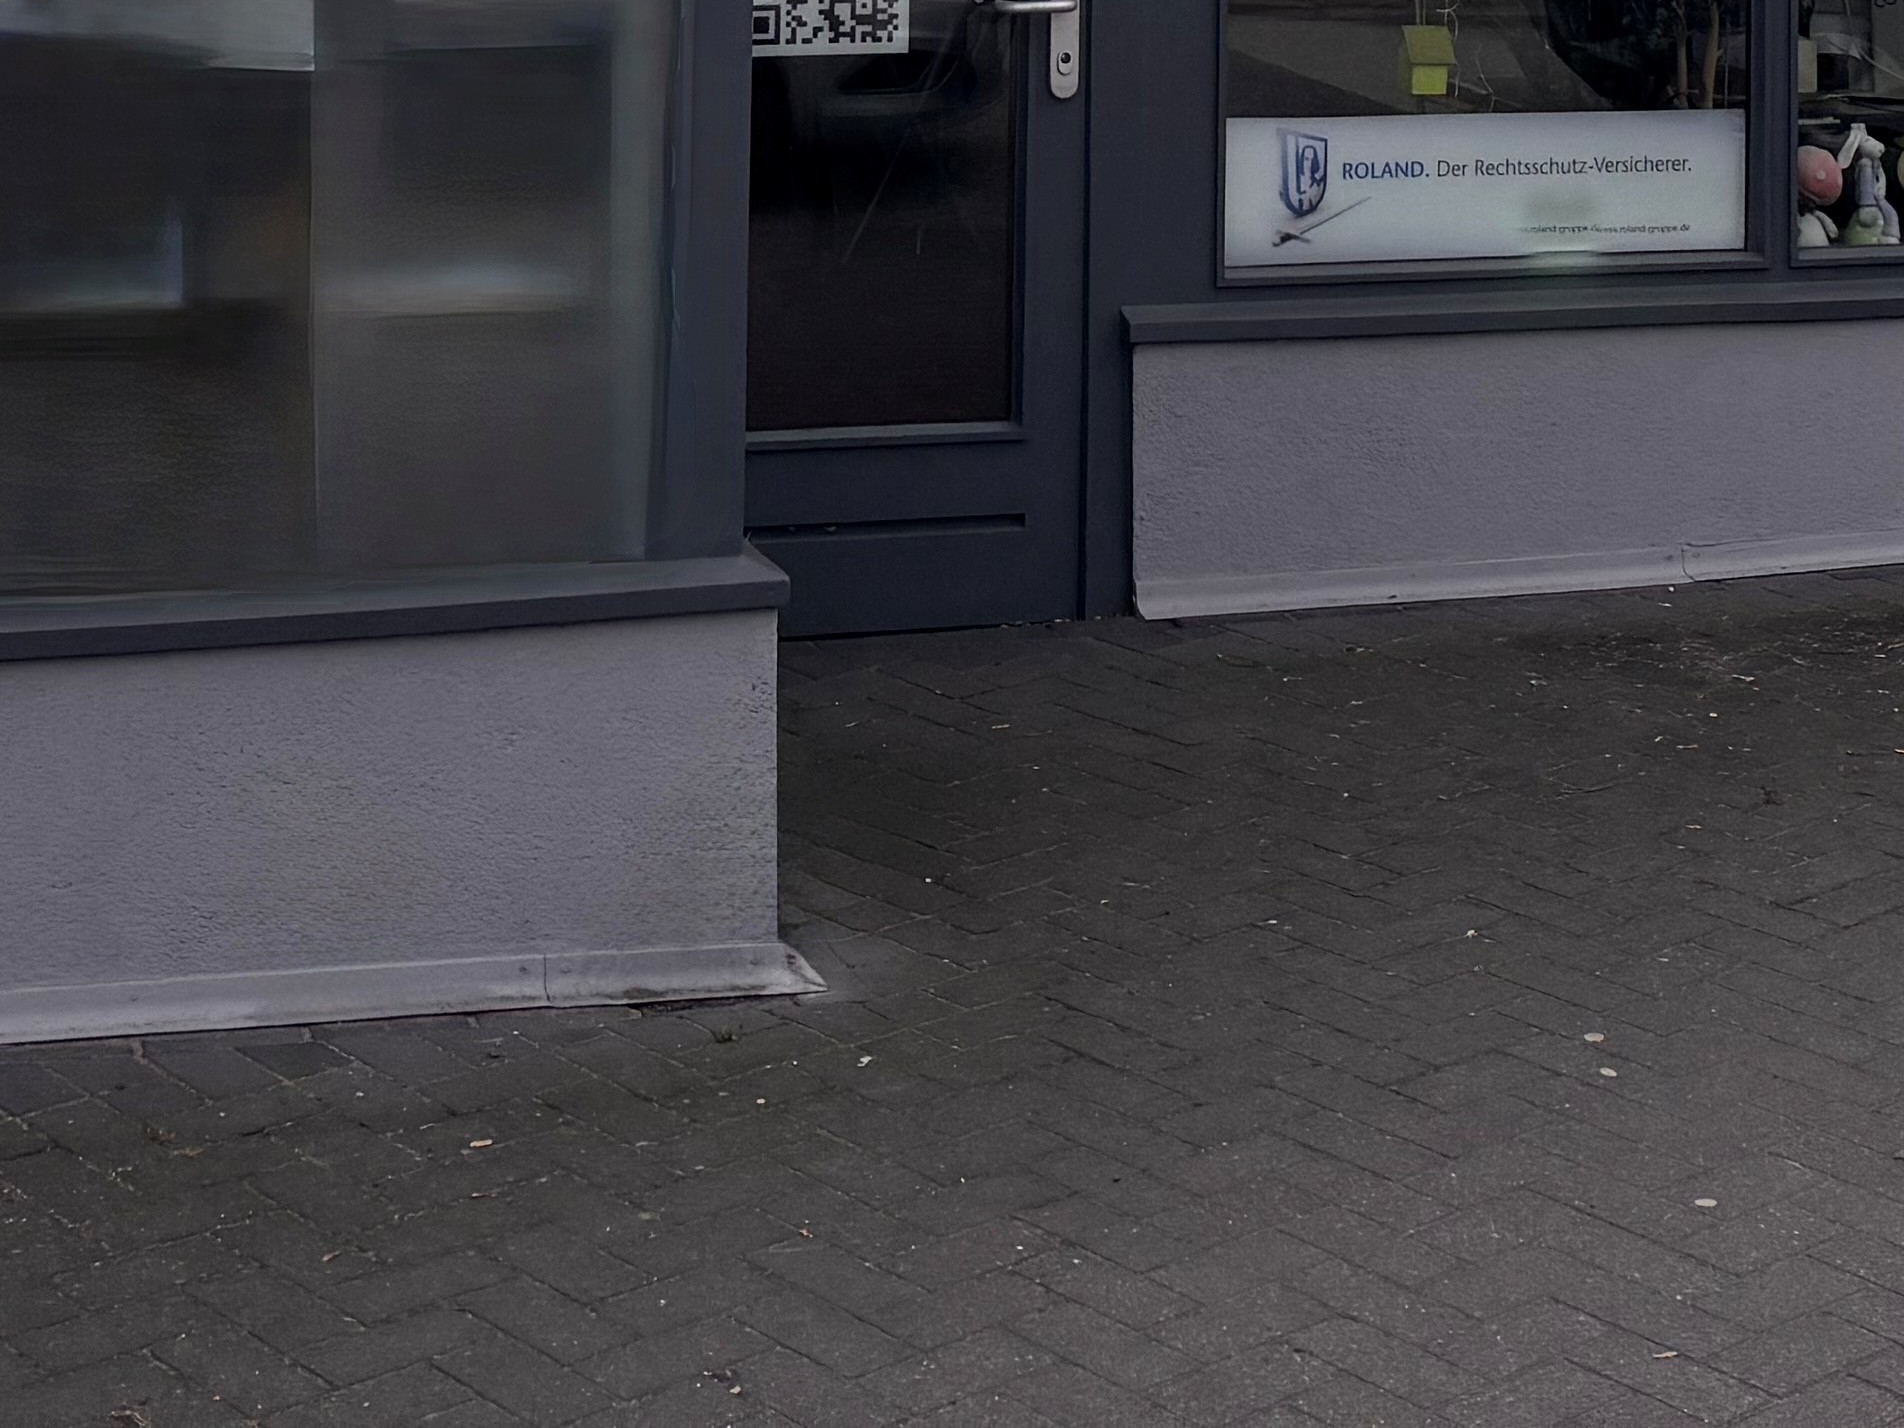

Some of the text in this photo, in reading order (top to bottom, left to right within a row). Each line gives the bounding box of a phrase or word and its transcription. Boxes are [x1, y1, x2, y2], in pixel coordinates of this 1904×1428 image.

[1341, 155, 1693, 180] ROLAND. Der Rechtsschutz-Versicherer.
